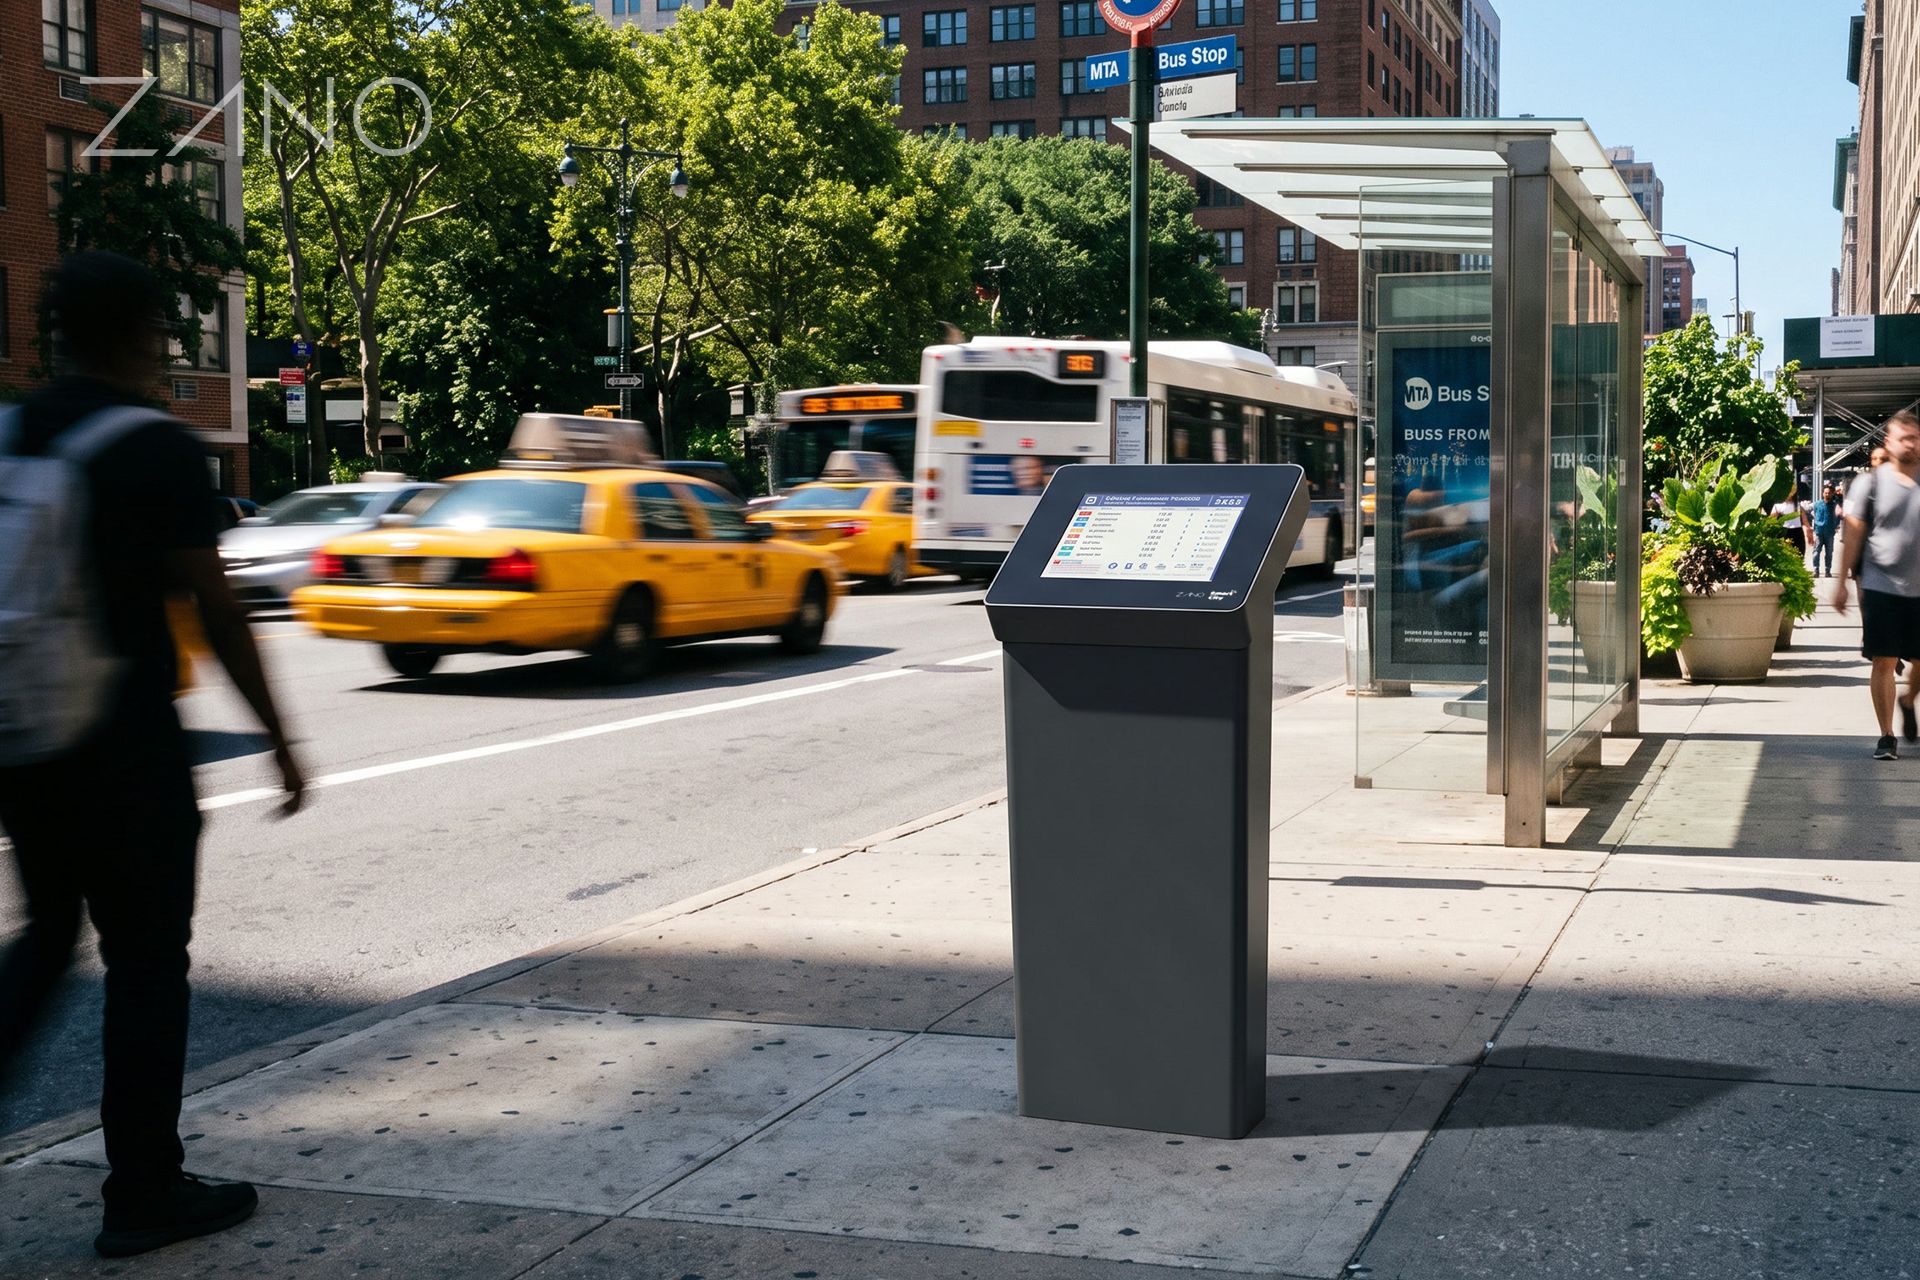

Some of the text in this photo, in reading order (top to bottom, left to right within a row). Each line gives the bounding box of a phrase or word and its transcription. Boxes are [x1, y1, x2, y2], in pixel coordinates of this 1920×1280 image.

[1158, 47, 1228, 70] Bus Stop
[1090, 61, 1120, 81] MTA
[1404, 385, 1429, 403] MTA
[1438, 385, 1472, 402] Bus
[1404, 428, 1491, 441] BUSS FROM
